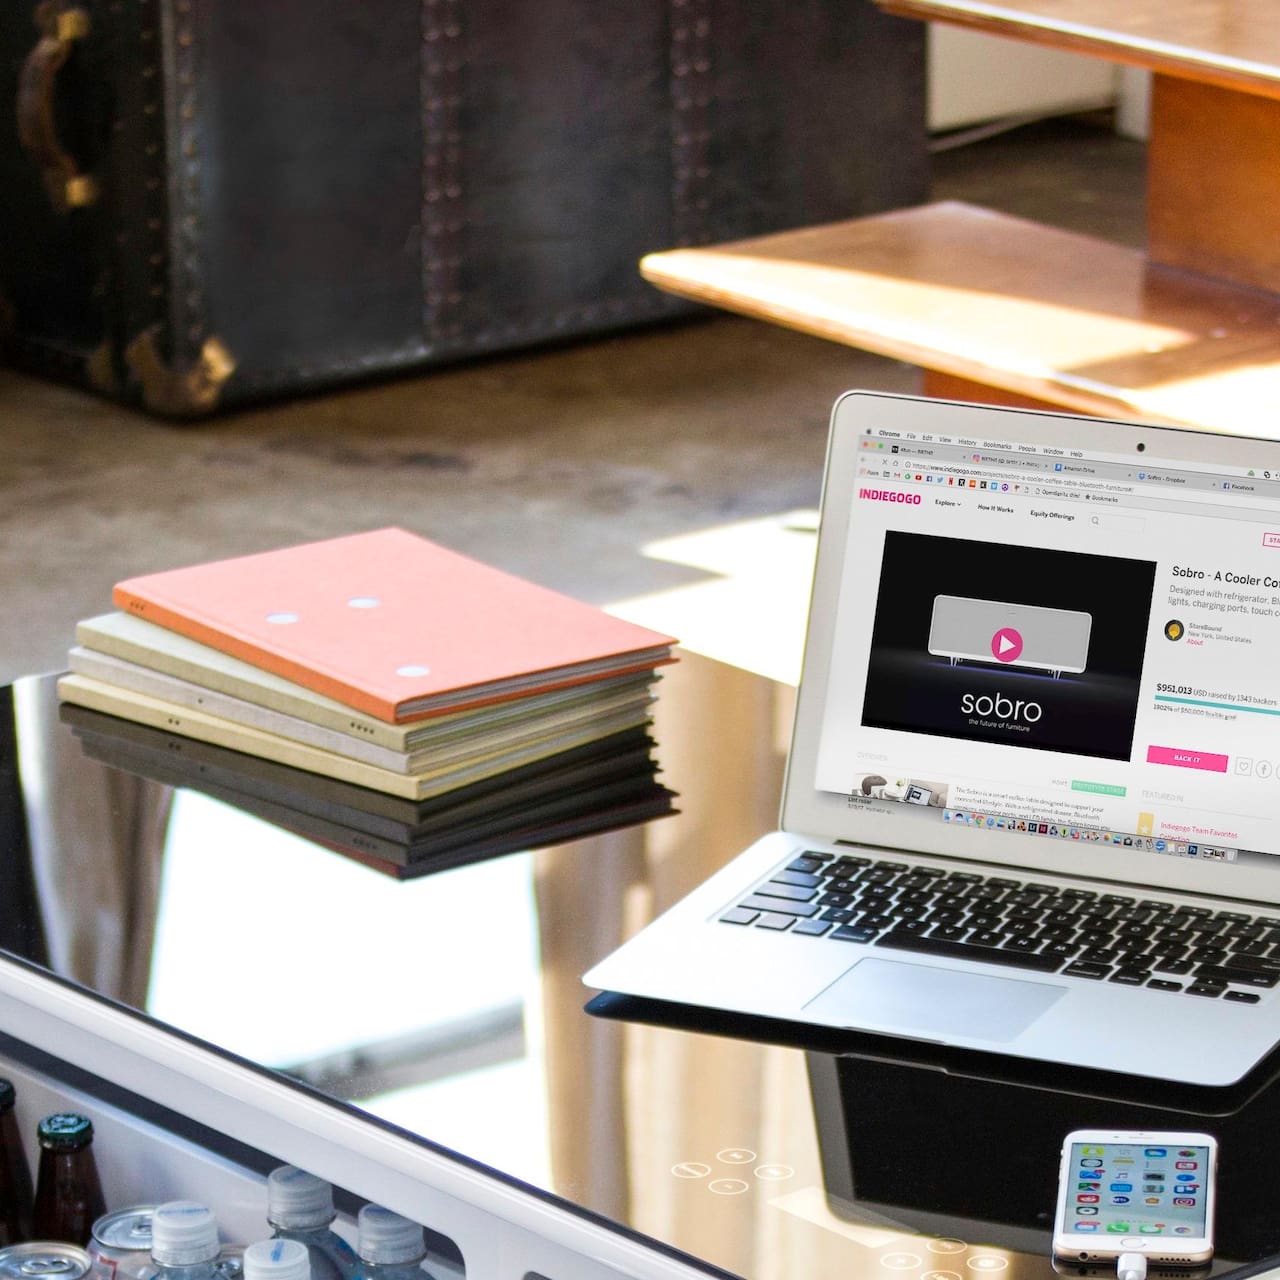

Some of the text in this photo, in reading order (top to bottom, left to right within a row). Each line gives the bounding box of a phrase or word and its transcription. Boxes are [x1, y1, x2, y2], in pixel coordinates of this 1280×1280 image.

[879, 430, 900, 438] Chrome
[959, 438, 977, 446] History
[984, 442, 1012, 450] Bookmarks
[1019, 445, 1036, 453] People
[1043, 448, 1064, 456] Window
[859, 488, 922, 505] INDIEGOGO
[935, 499, 956, 507] Explore
[996, 506, 1014, 514] Works
[1030, 510, 1075, 521] Equity Offerings
[1172, 565, 1205, 580] Sobro
[1214, 570, 1222, 581] A
[1225, 572, 1261, 587] Cooler
[1169, 584, 1205, 598] Designed
[1206, 588, 1223, 599] with
[1223, 590, 1270, 605] refrigerator,
[1168, 596, 1191, 608] lights,
[1192, 599, 1226, 613] charging
[1226, 604, 1249, 615] ports,
[1251, 606, 1273, 617] touch
[1186, 638, 1204, 647] About
[1187, 630, 1200, 638] New
[1215, 633, 1234, 642] United
[1234, 636, 1252, 644] States
[1156, 683, 1193, 696] $951,013
[1193, 687, 1207, 697] USD
[1208, 689, 1228, 700] raised
[1253, 696, 1278, 706] backers
[960, 692, 1042, 723] sobro
[980, 719, 998, 728] future
[1006, 723, 1031, 732] furniture
[1173, 753, 1193, 764] BACK
[1141, 790, 1176, 801] FEATURED
[1160, 821, 1239, 839] Indiegogo Team Favorites
